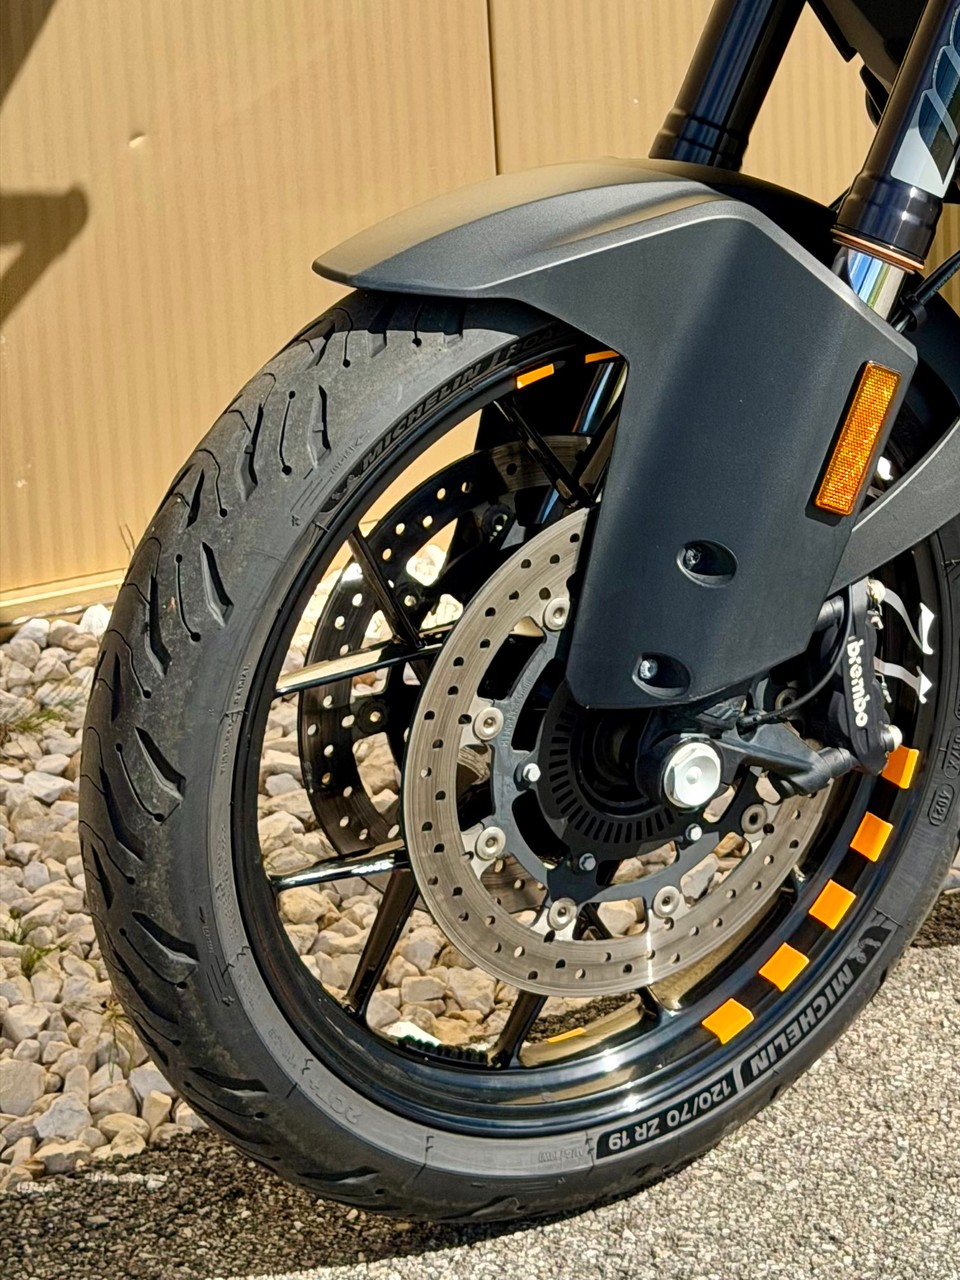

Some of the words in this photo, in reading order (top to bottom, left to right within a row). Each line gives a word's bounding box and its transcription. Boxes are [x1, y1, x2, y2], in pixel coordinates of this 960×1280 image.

[359, 362, 483, 472] MICHELIN
[846, 636, 869, 728] brembo
[750, 964, 853, 1076] MICHELIN
[634, 1118, 660, 1143] ZR
[666, 1080, 733, 1128] 120/70
[608, 1130, 630, 1151] 19
